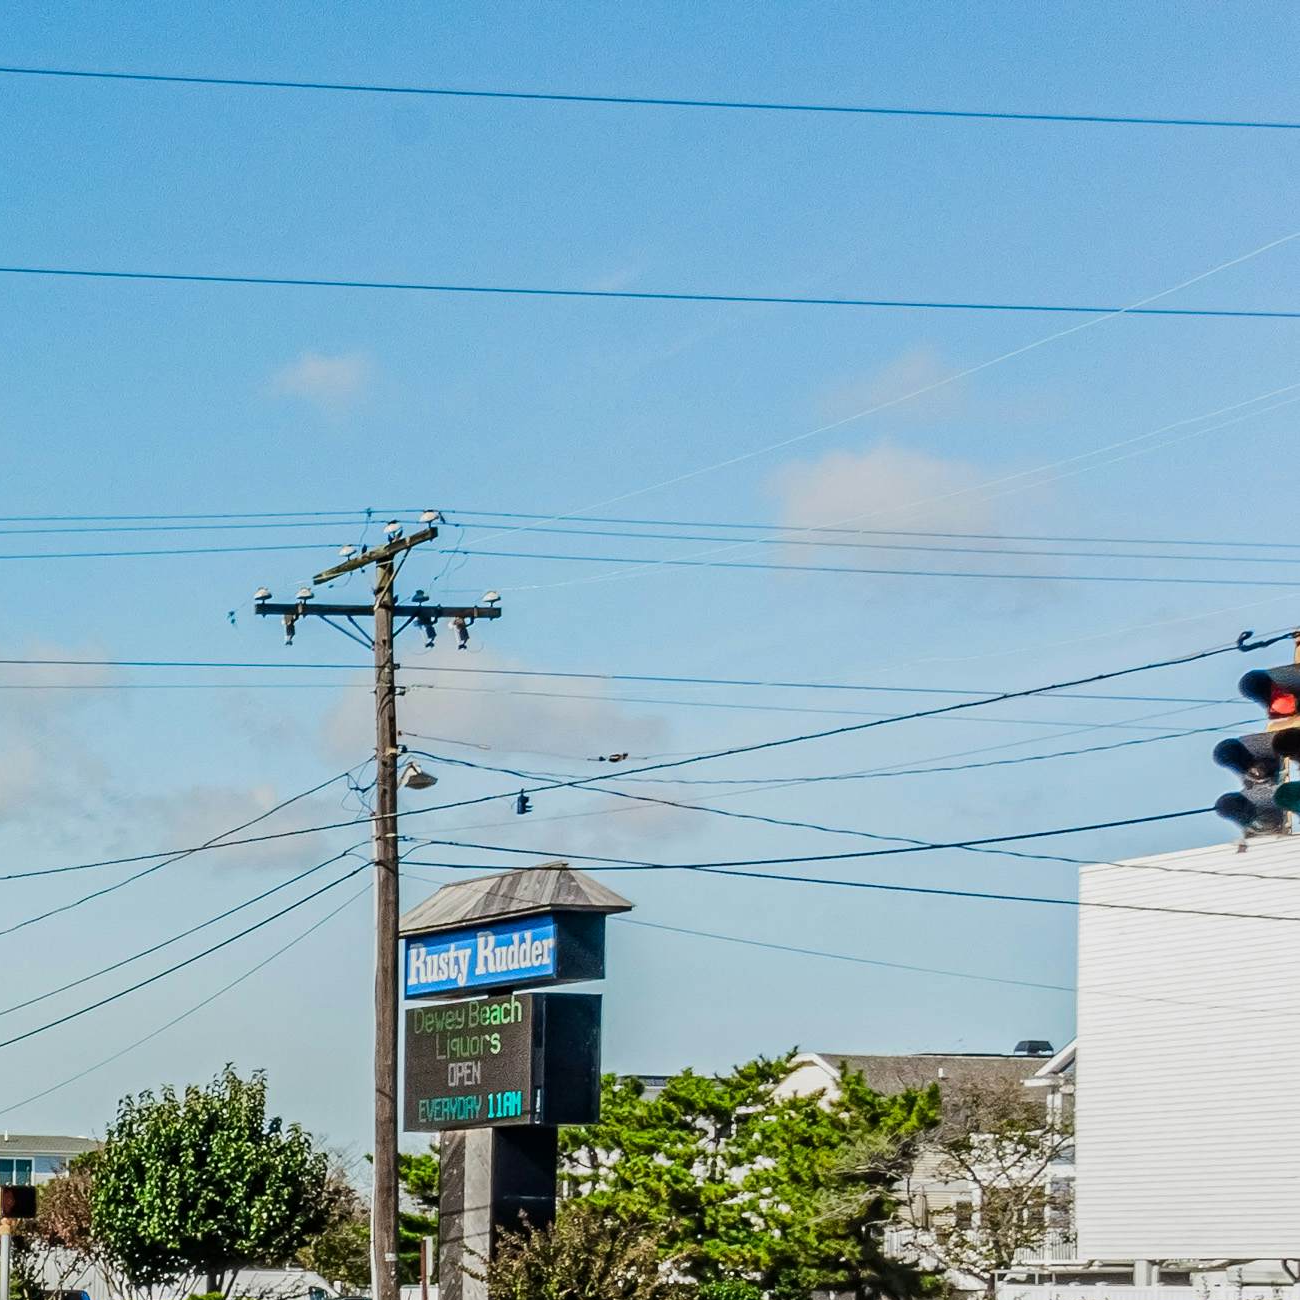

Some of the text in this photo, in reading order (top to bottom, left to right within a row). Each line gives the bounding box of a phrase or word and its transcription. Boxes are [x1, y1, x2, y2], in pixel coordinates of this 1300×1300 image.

[407, 931, 555, 987] Rusty Rudder
[414, 995, 522, 1034] Dewey Beach
[436, 1032, 501, 1060] Liquors
[448, 1061, 481, 1087] OPEN
[418, 1095, 483, 1123] EVERYDAY
[487, 1090, 521, 1118] 11AM
